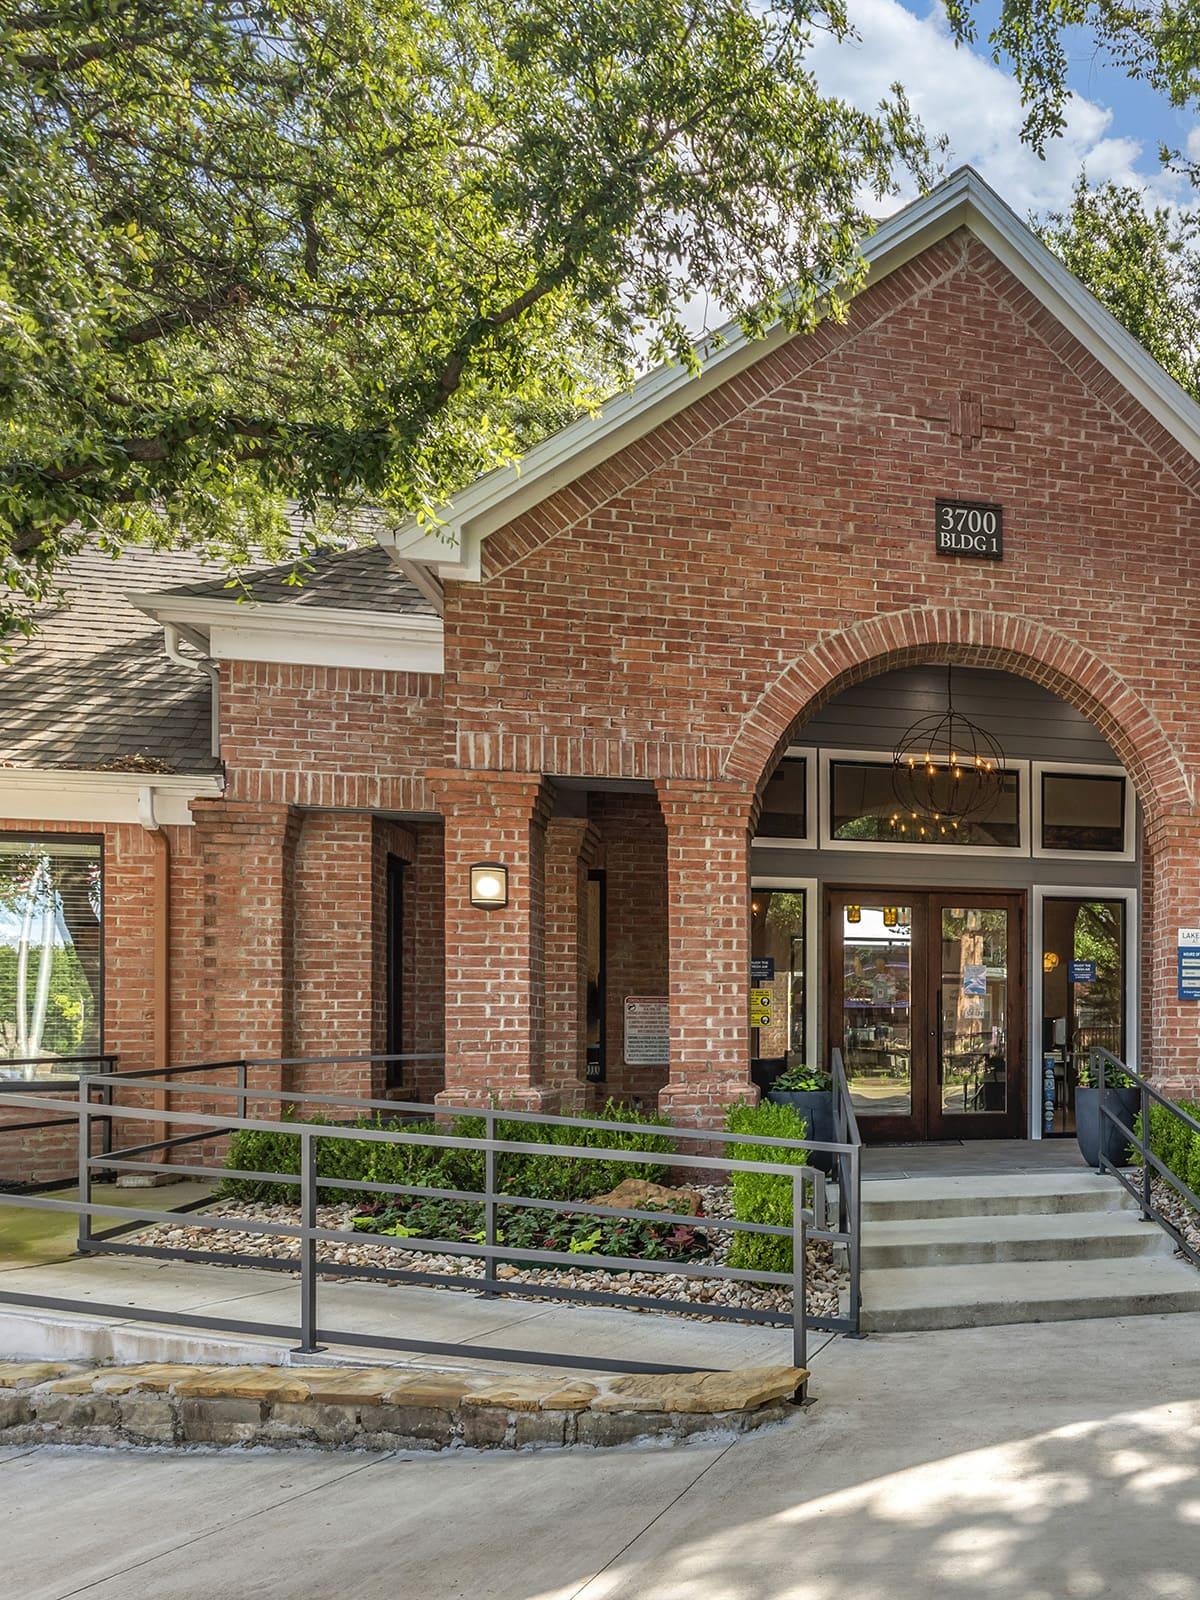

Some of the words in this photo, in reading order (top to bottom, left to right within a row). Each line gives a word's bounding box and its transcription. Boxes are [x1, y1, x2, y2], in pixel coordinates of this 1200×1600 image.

[941, 507, 996, 534] 3700
[940, 532, 986, 551] BLDG
[991, 537, 998, 553] 1
